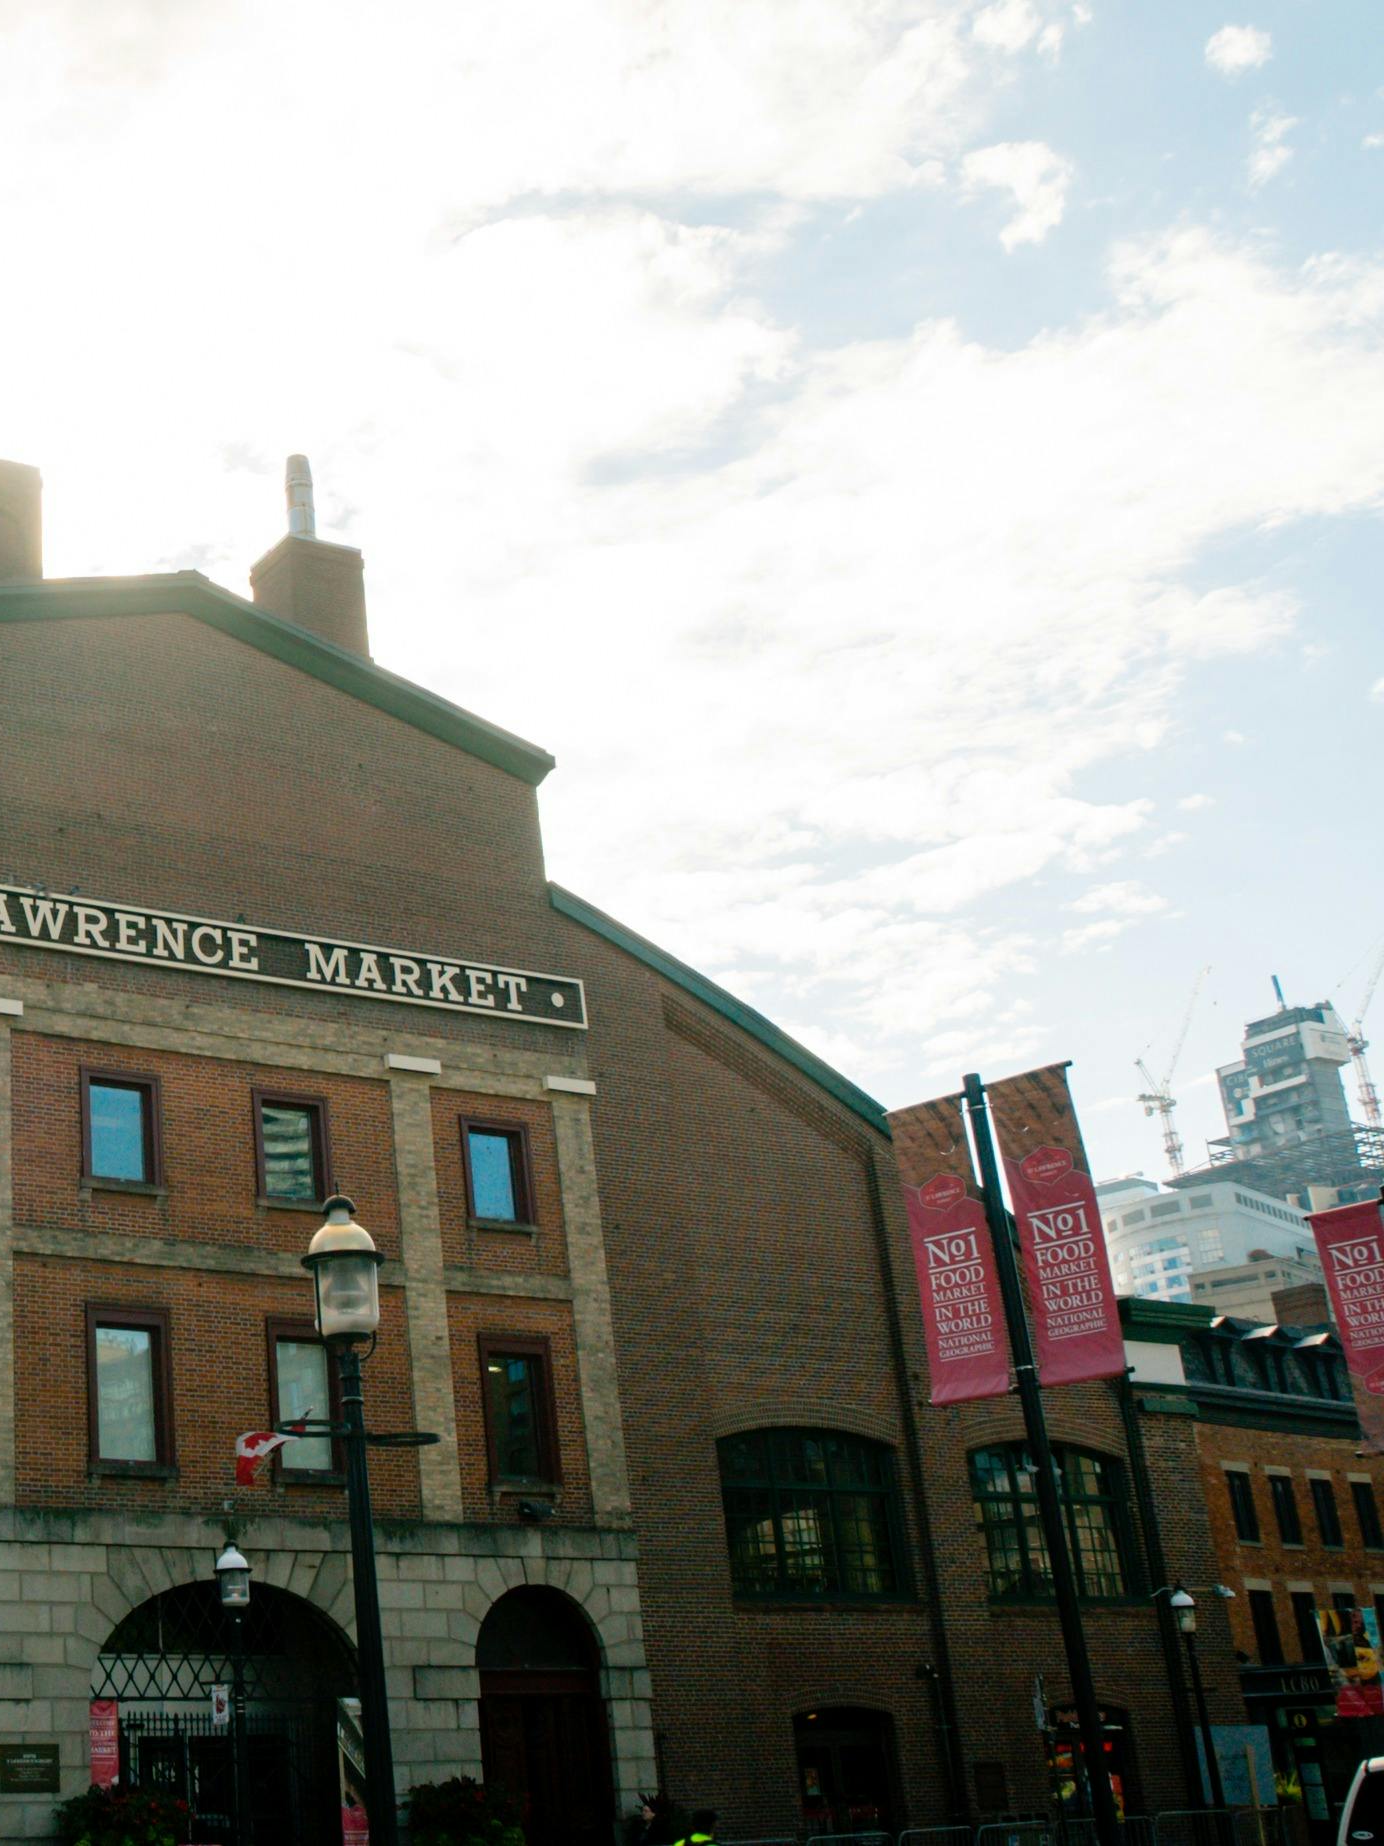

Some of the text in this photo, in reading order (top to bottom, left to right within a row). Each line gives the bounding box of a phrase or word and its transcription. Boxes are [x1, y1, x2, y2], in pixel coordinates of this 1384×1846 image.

[304, 942, 527, 1011] MARKET
[1251, 1035, 1297, 1057] SQUARE
[1035, 1240, 1095, 1266] FOOD
[930, 1265, 985, 1290] FOOD
[1038, 1257, 1097, 1280] MARKET
[932, 1281, 986, 1304] MARKET
[1042, 1275, 1101, 1299] IN THE
[935, 1299, 990, 1321] IN THE
[1044, 1289, 1104, 1312] WORLD
[1343, 1302, 1361, 1316] IN
[936, 1313, 992, 1334] WORLD
[1046, 1310, 1106, 1328] NATIONAL
[1047, 1320, 1107, 1337] GEOGRAPHIC
[938, 1331, 994, 1349] NATIONAL
[939, 1342, 995, 1359] GEOGRAPHIC
